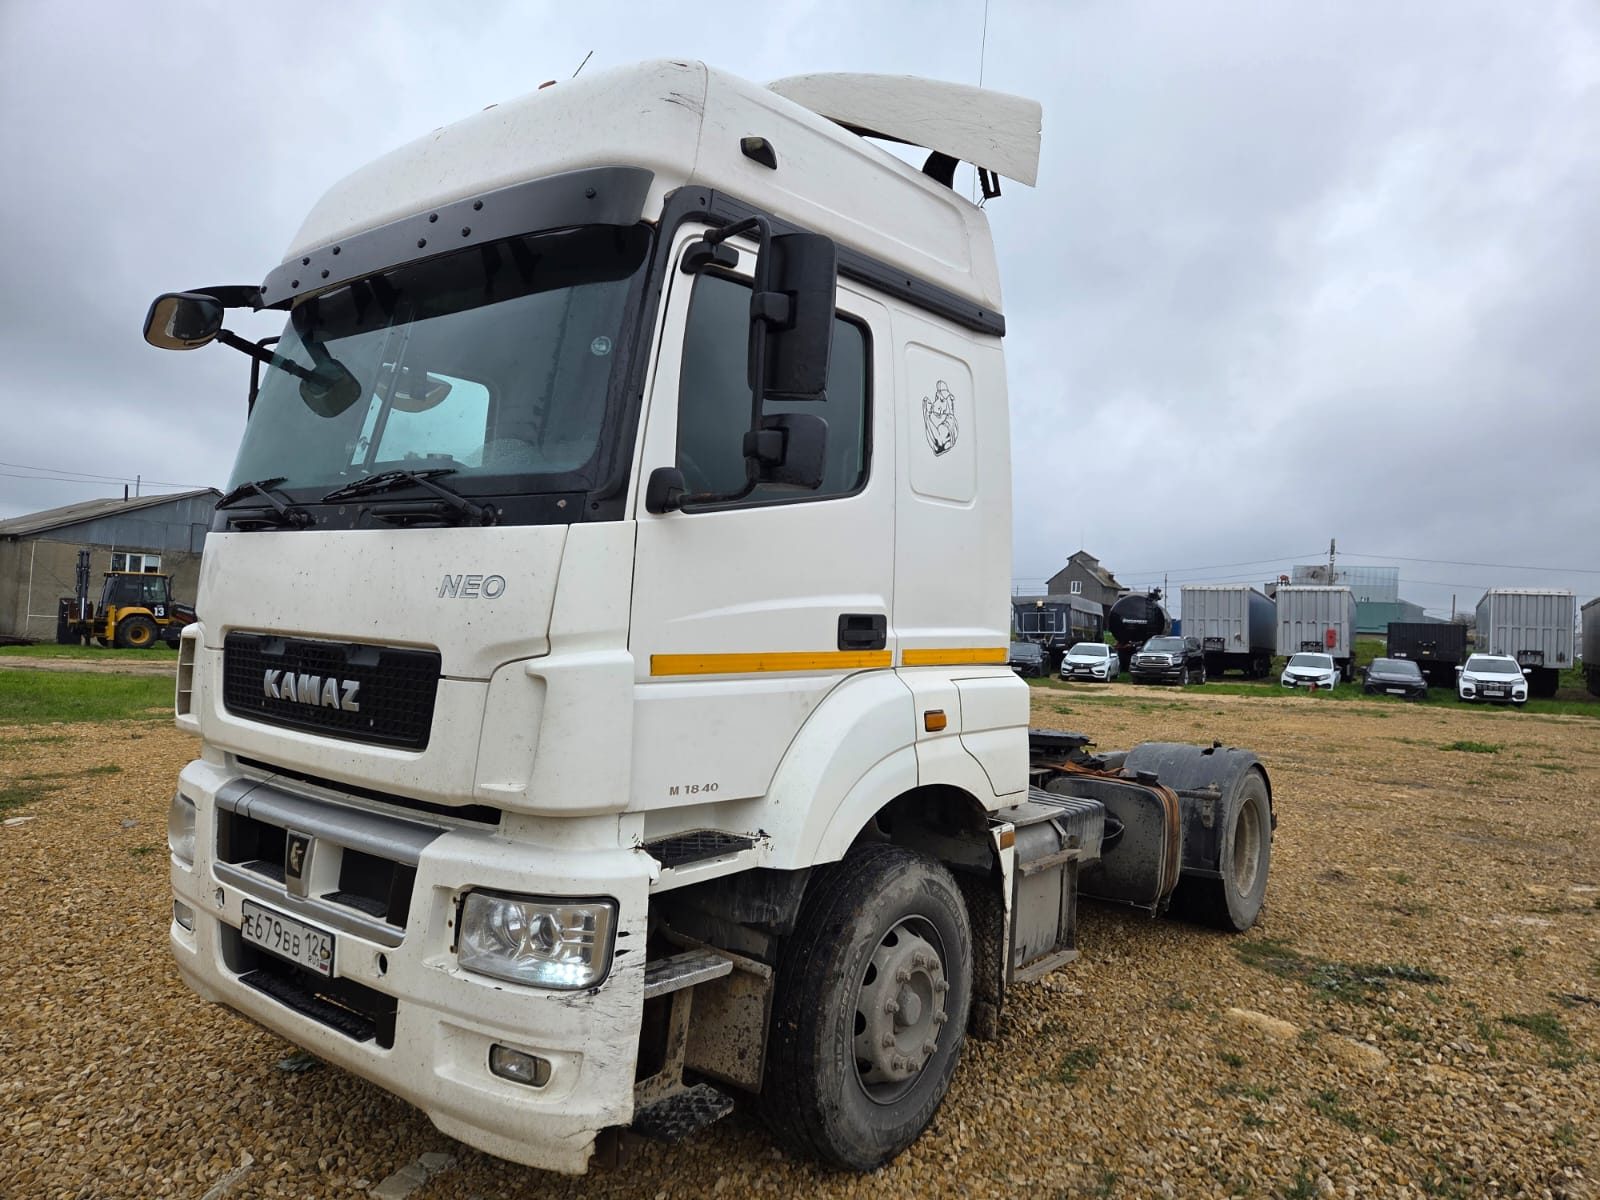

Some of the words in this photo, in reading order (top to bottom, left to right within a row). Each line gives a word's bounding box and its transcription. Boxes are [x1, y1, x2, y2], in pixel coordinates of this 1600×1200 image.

[438, 574, 507, 600] NEO
[153, 606, 166, 617] 13
[263, 668, 361, 713] KAMAZ
[669, 785, 680, 796] M
